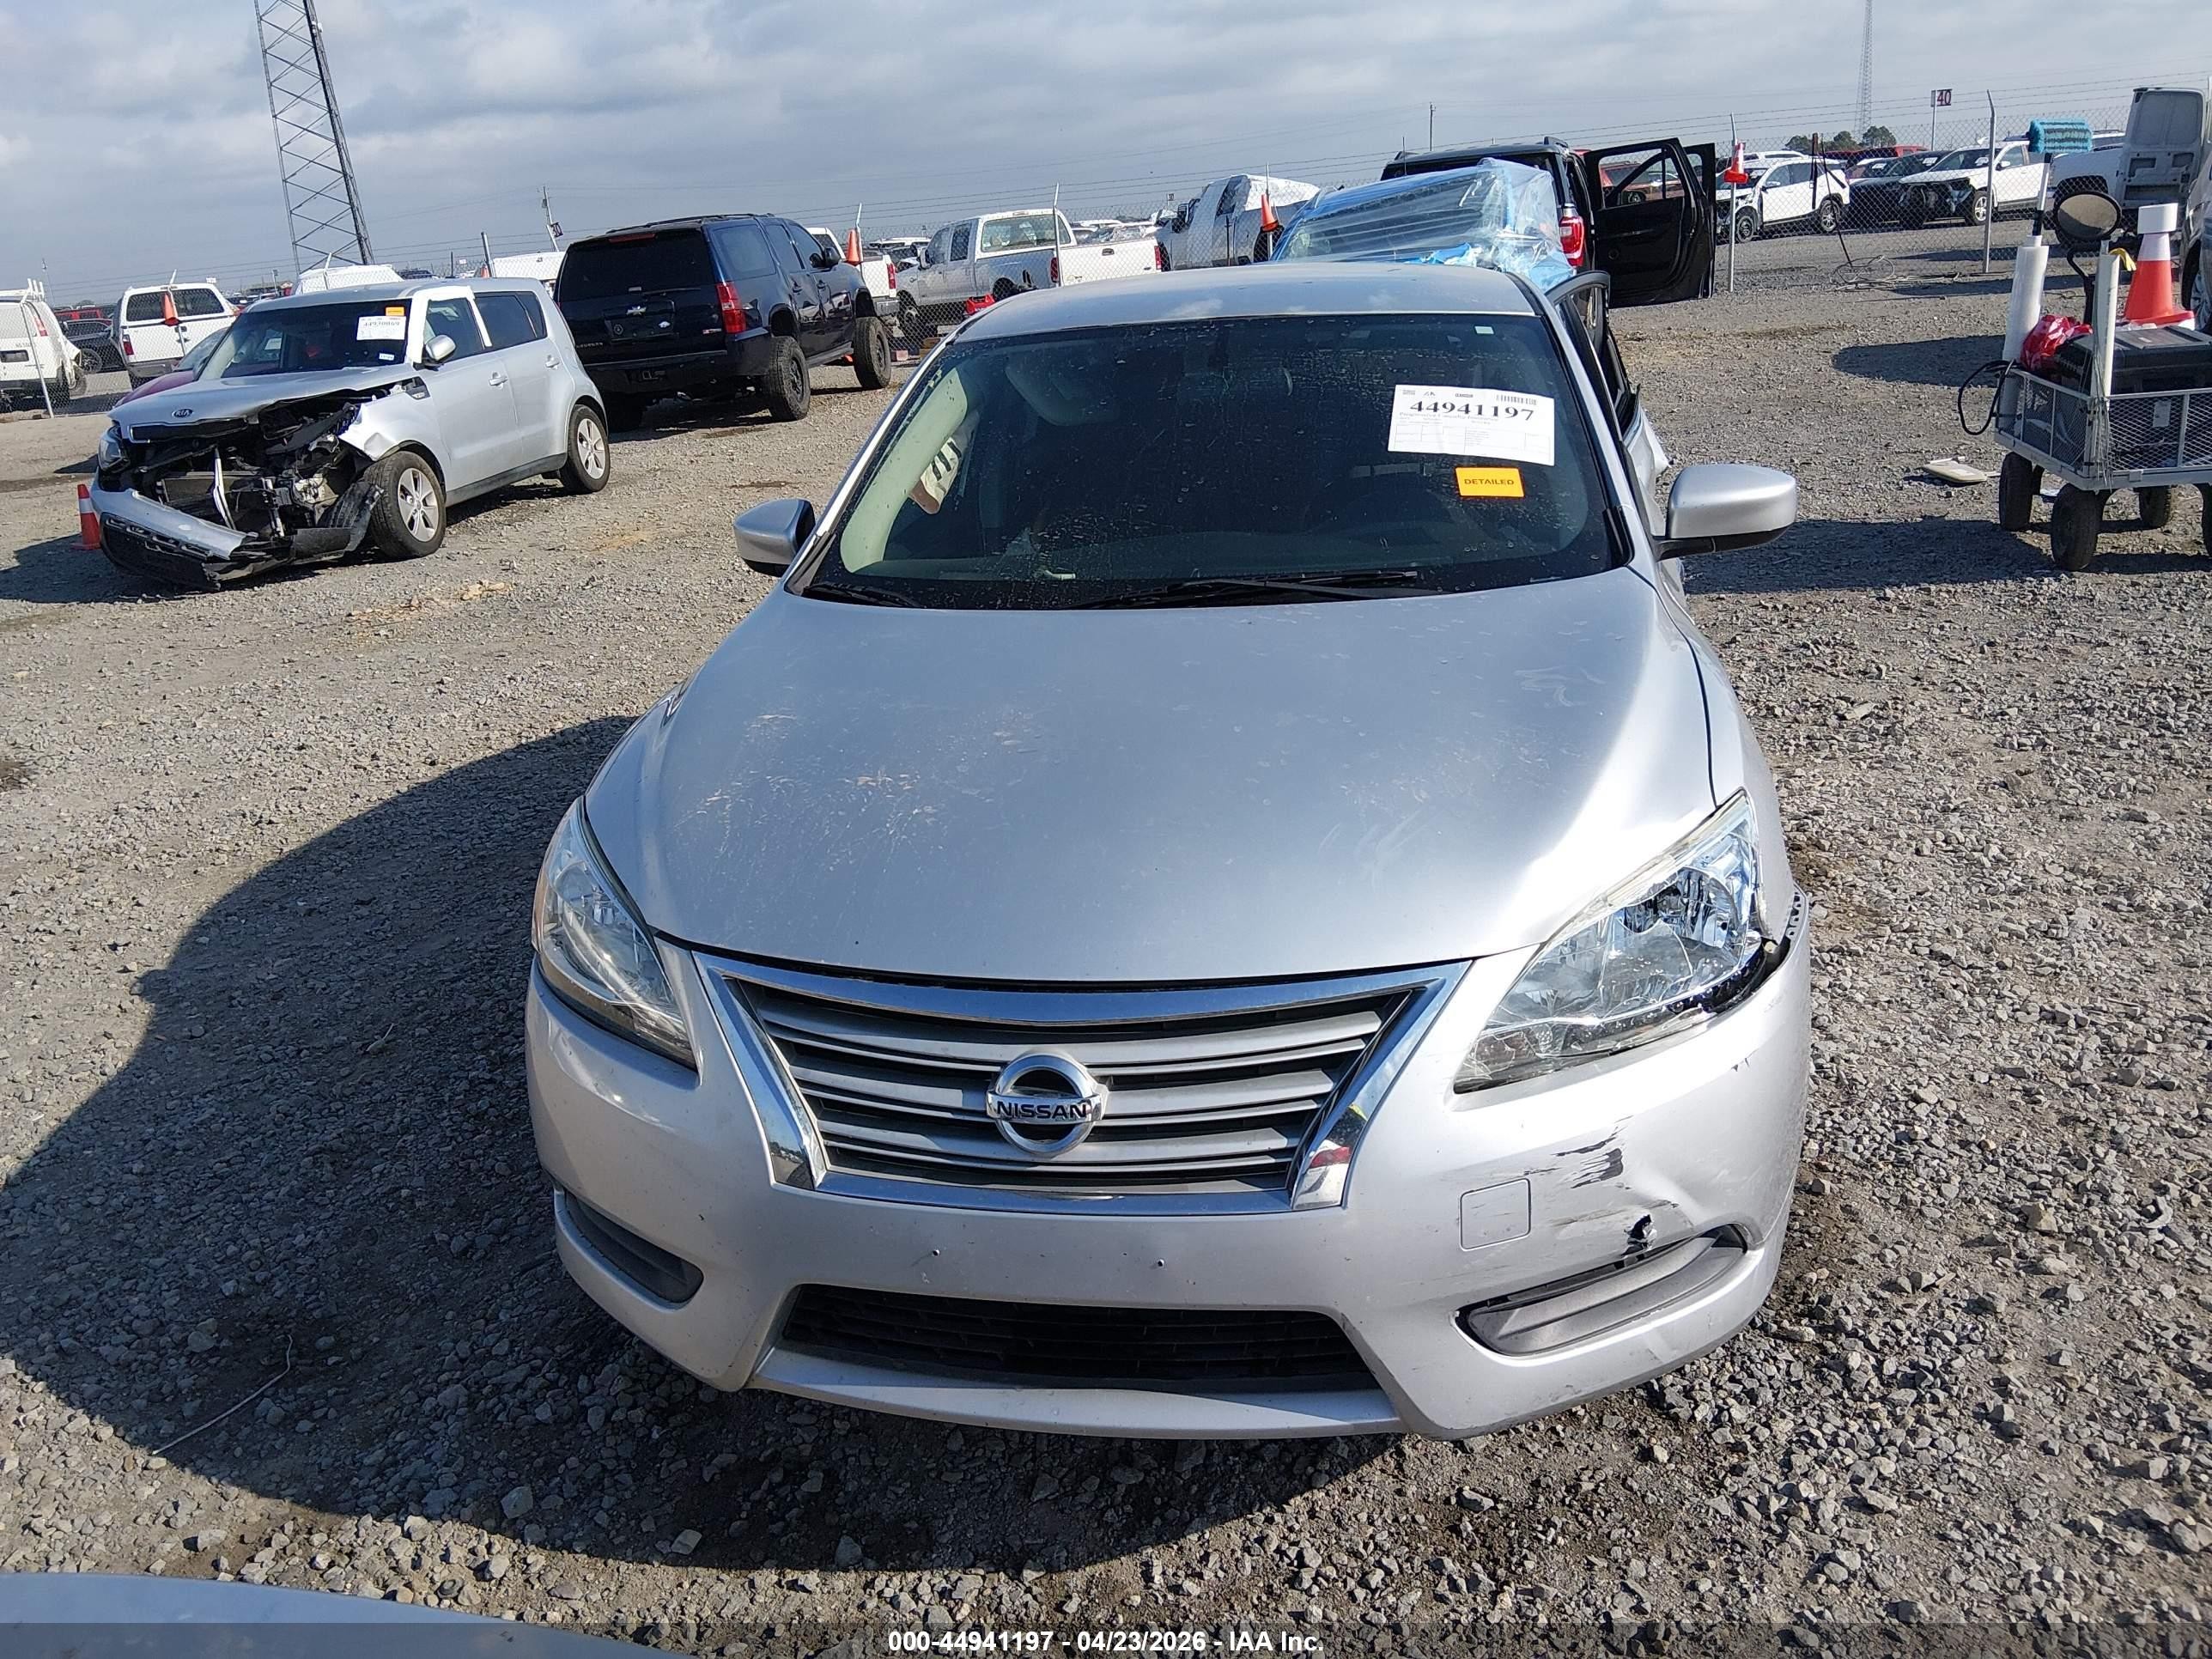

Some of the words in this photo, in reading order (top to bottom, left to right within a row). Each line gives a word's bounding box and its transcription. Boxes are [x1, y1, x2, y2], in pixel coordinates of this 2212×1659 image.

[1937, 89, 1951, 106] 40
[1410, 401, 1534, 421] 44941197
[996, 1101, 1087, 1120] NISSAN
